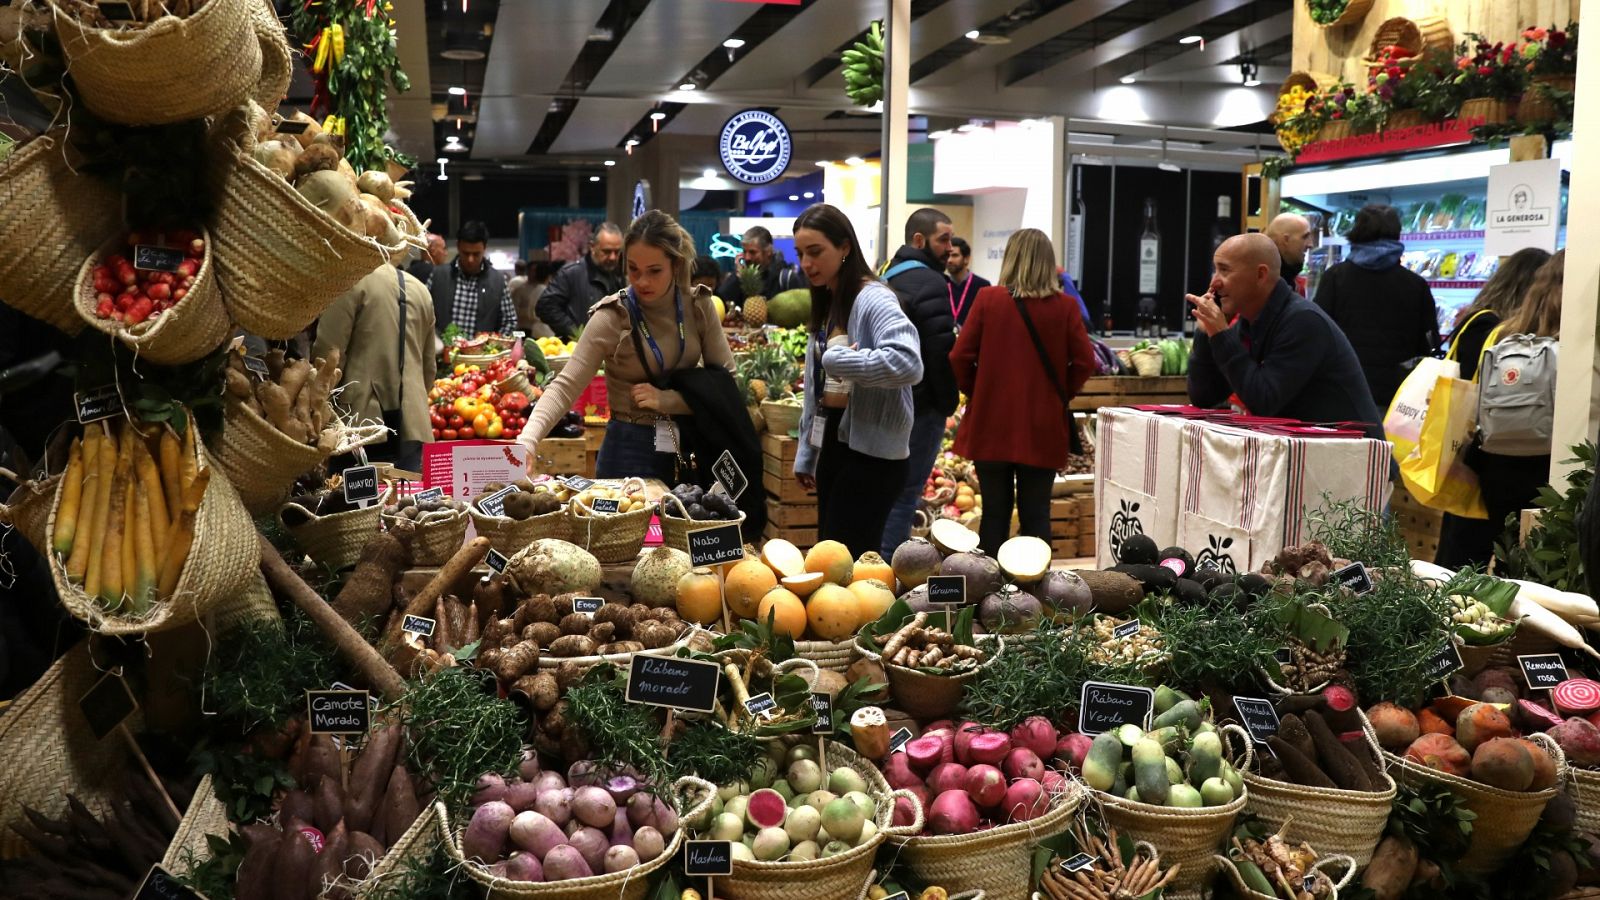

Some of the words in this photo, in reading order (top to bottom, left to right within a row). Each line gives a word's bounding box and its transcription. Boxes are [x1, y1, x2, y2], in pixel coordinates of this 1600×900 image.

[1507, 214, 1544, 222] GENEROSA
[1396, 402, 1419, 421] Happy
[464, 473, 468, 482] 1
[349, 479, 374, 490] HUAYRO
[463, 487, 469, 496] 2
[693, 536, 720, 547] Nabo
[692, 552, 715, 563] bola
[715, 550, 726, 559] de
[727, 548, 743, 556] oro
[1525, 661, 1563, 670] Remolacha
[1537, 674, 1558, 682] rosa
[1090, 690, 1133, 705] Rábano
[312, 697, 365, 711] Camote
[316, 714, 360, 727] Morado
[1089, 710, 1123, 722] Verde
